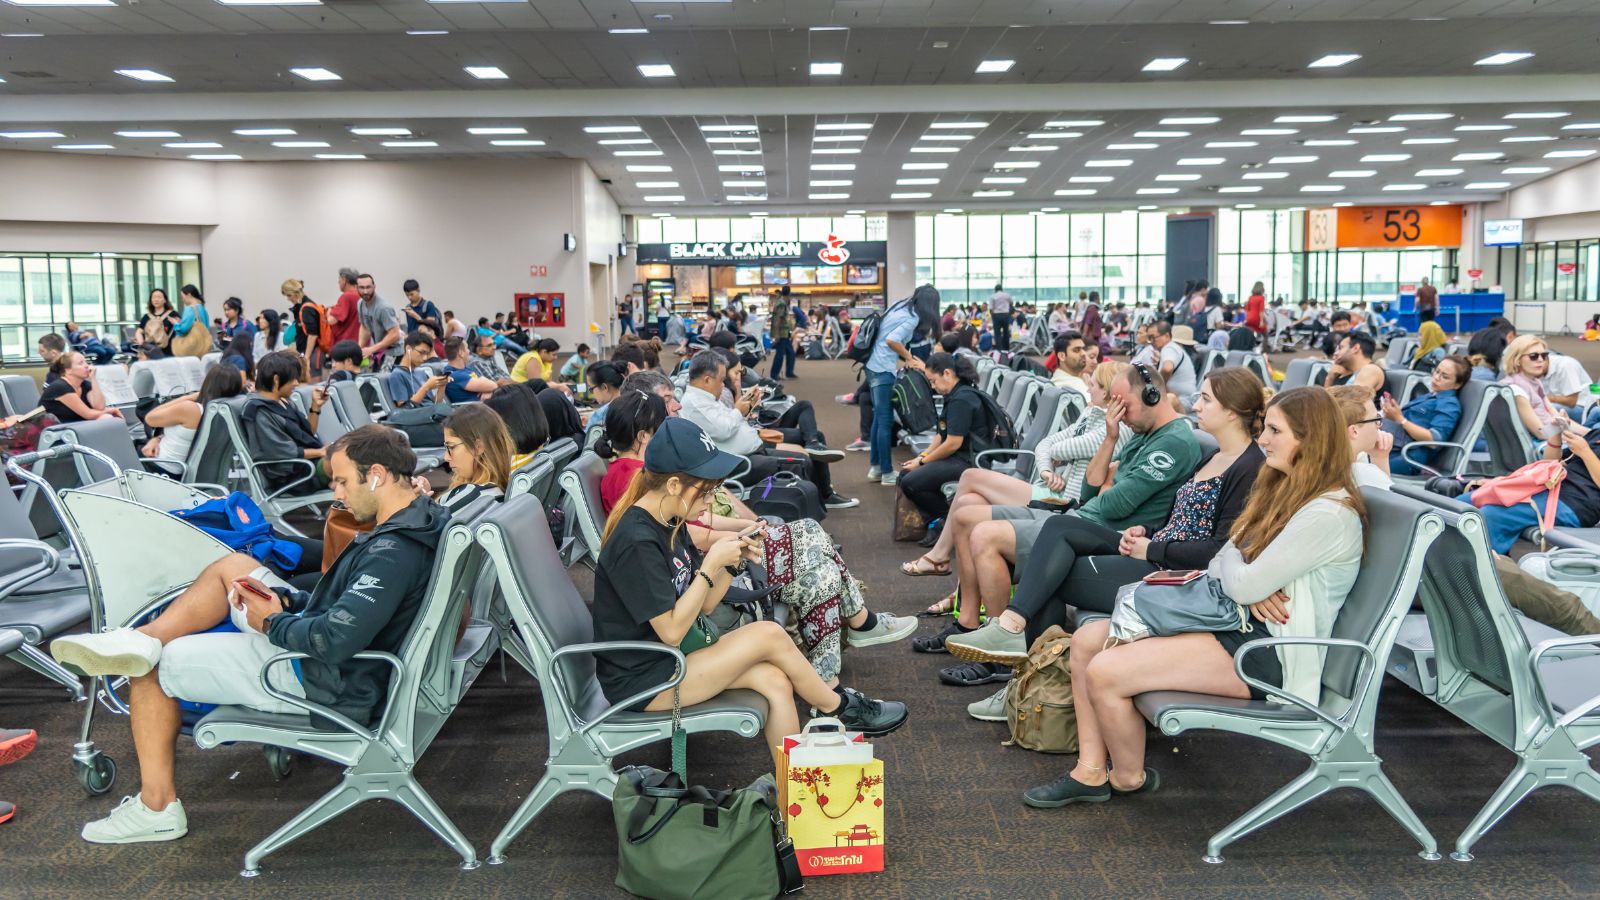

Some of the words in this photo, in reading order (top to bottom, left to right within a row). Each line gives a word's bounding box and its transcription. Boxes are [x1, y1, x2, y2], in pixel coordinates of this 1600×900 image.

[1383, 209, 1421, 242] 53
[670, 243, 726, 257] BLACK
[730, 242, 801, 257] CANYON
[1148, 451, 1174, 470] G
